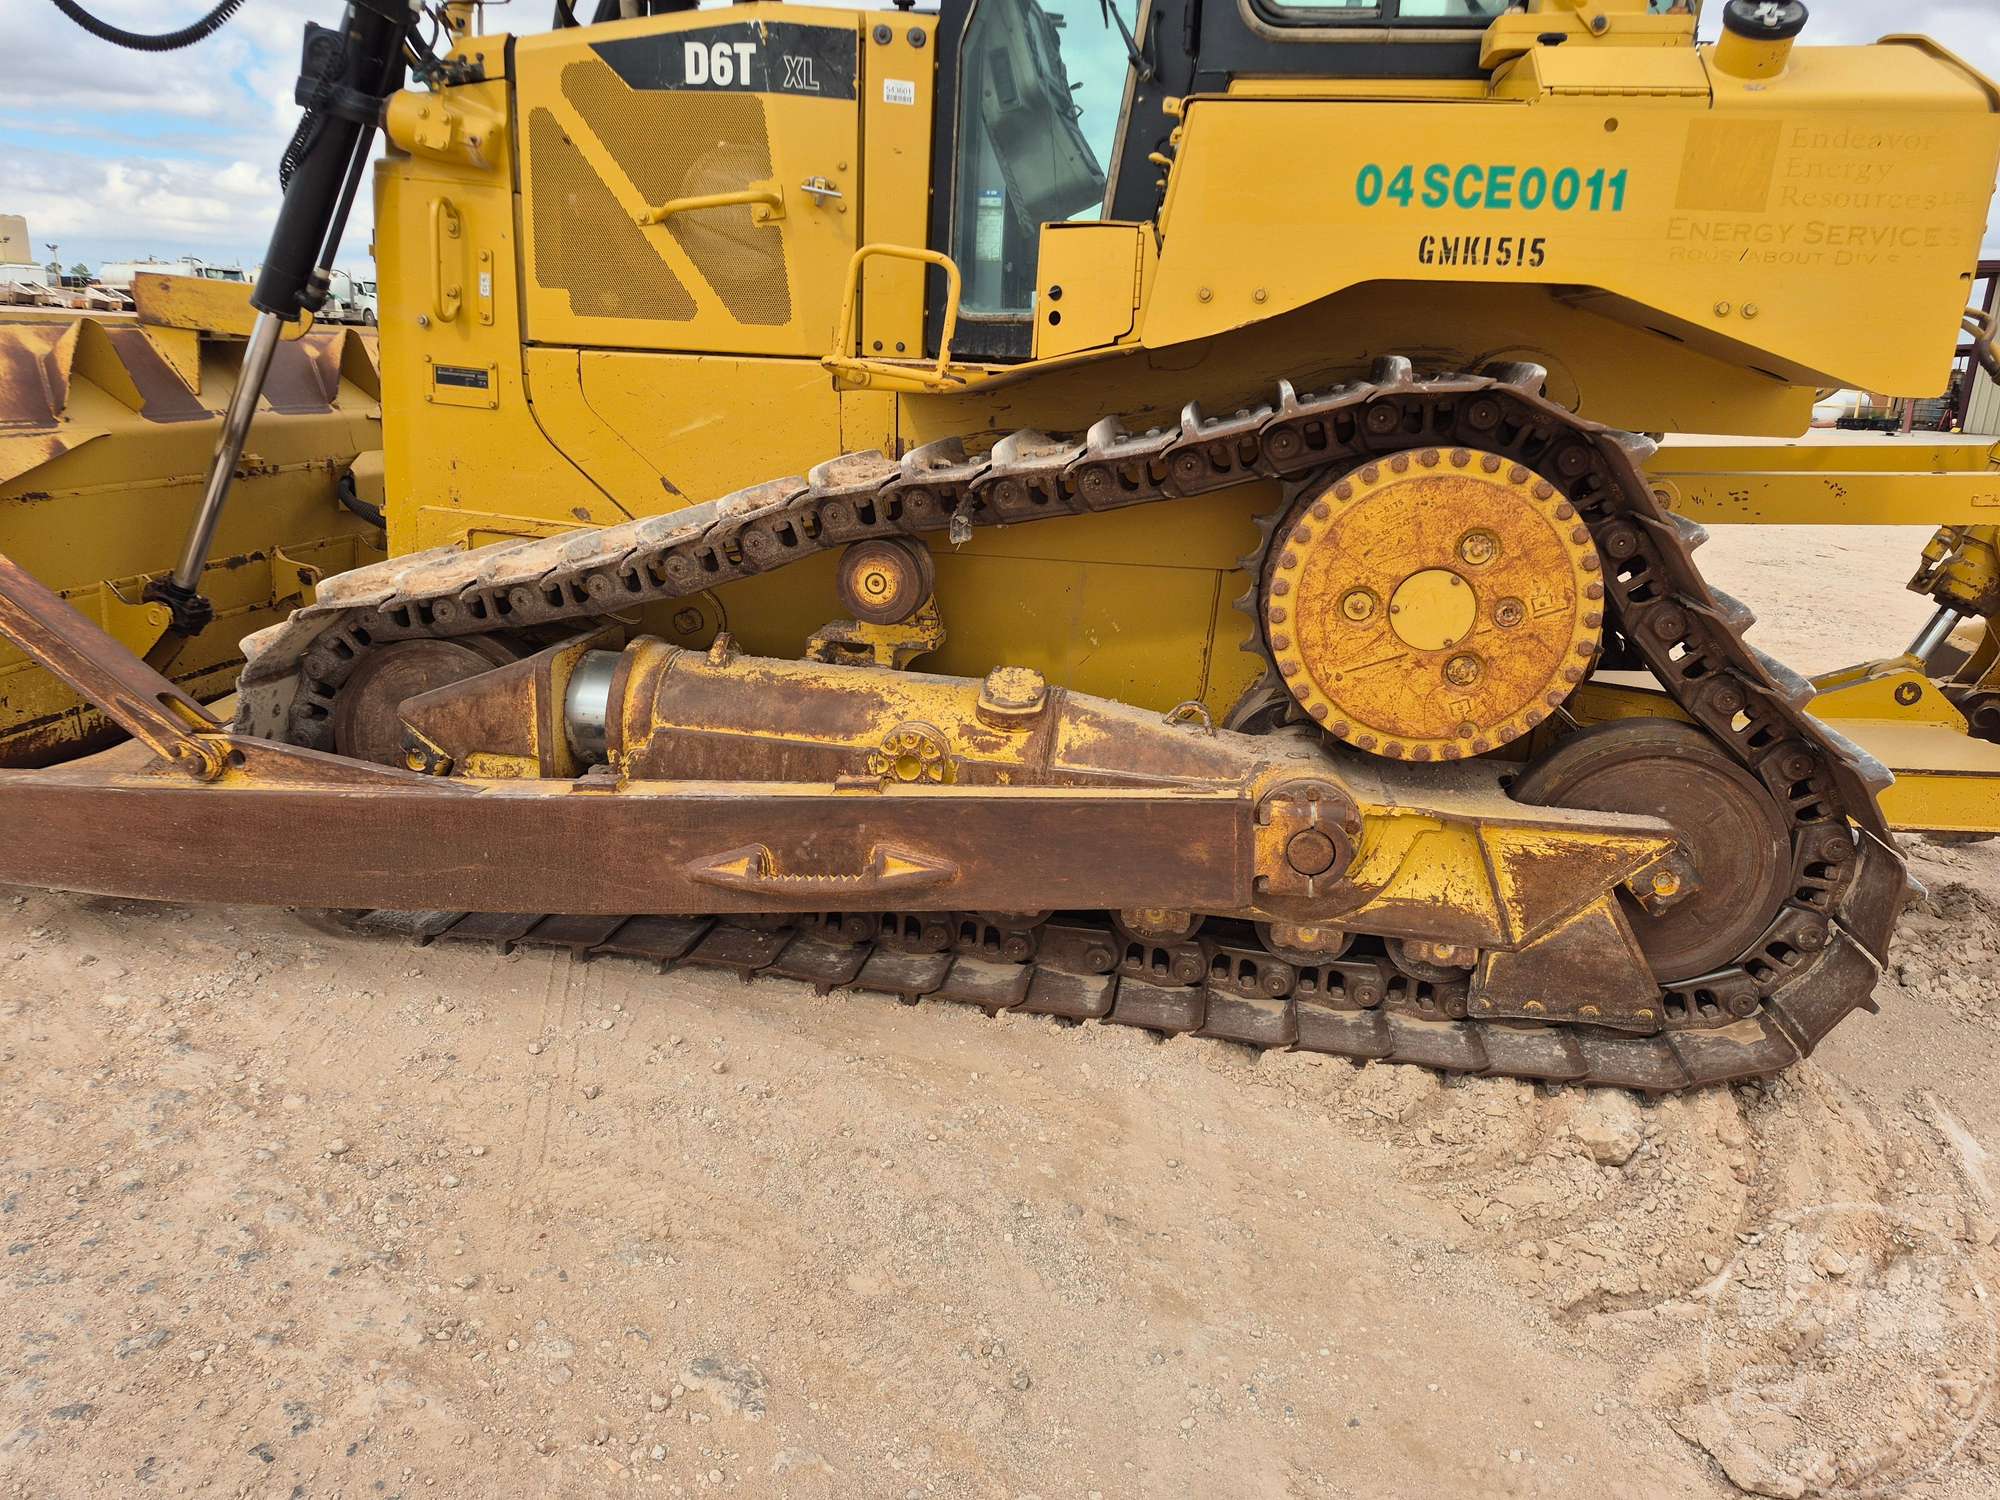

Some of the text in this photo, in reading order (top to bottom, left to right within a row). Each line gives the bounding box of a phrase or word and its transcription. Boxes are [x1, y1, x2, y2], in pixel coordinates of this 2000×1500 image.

[684, 41, 819, 91] D6T XL
[1790, 126, 1938, 151] Endeavor
[1785, 156, 1896, 184] Energy
[1355, 163, 1627, 212] 04SCE0011
[1665, 215, 1795, 244] ENERGY
[1418, 235, 1546, 267] GMK1515
